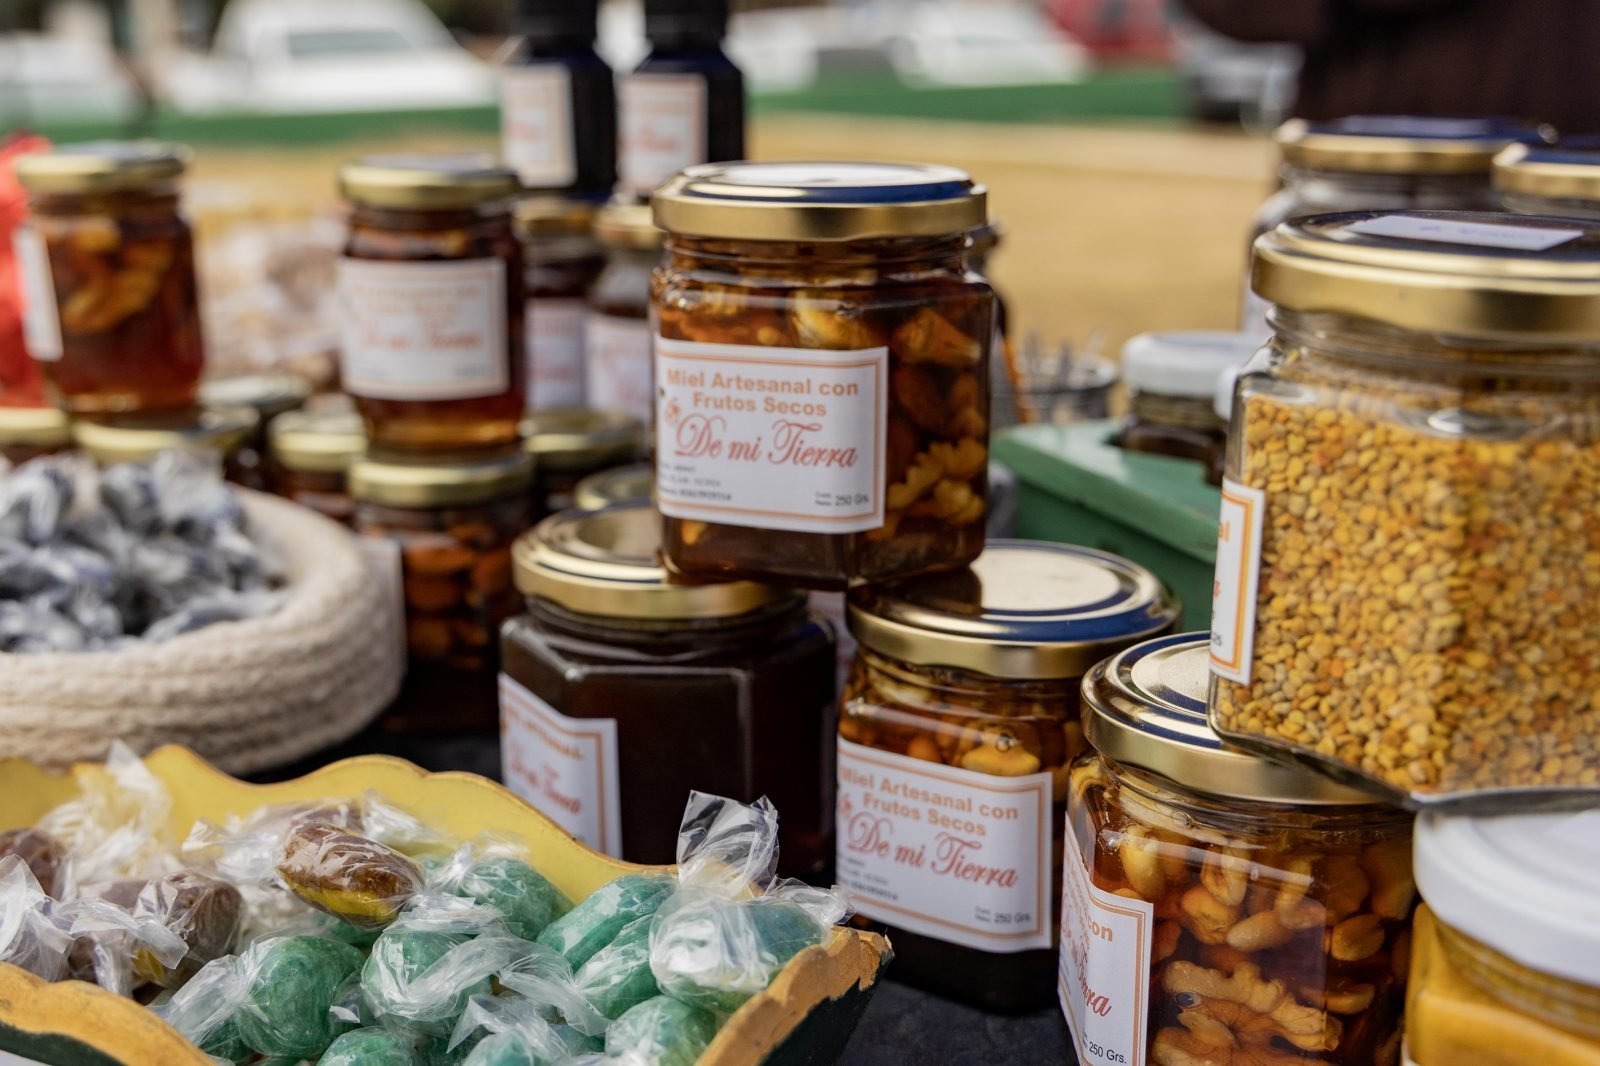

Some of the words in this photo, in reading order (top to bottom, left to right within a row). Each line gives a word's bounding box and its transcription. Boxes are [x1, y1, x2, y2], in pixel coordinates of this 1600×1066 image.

[666, 368, 705, 388] Miel
[711, 372, 812, 395] Artesanal
[818, 382, 859, 397] con
[692, 391, 757, 413] Frutos
[763, 396, 827, 417] Secos
[674, 413, 726, 460] De
[728, 436, 763, 462] mi
[768, 418, 858, 469] Tierra
[835, 494, 852, 506] 250
[841, 765, 875, 789] Miel
[880, 777, 973, 813] Artesanal
[978, 803, 1019, 820] con
[862, 793, 922, 821] Frutos
[927, 808, 987, 837] Secos
[846, 811, 894, 856] De
[894, 842, 925, 868] mi
[930, 831, 1019, 888] Tierra
[993, 911, 1012, 924] 250
[1089, 1041, 1104, 1058] 250
[1106, 1049, 1127, 1064] Grs.
